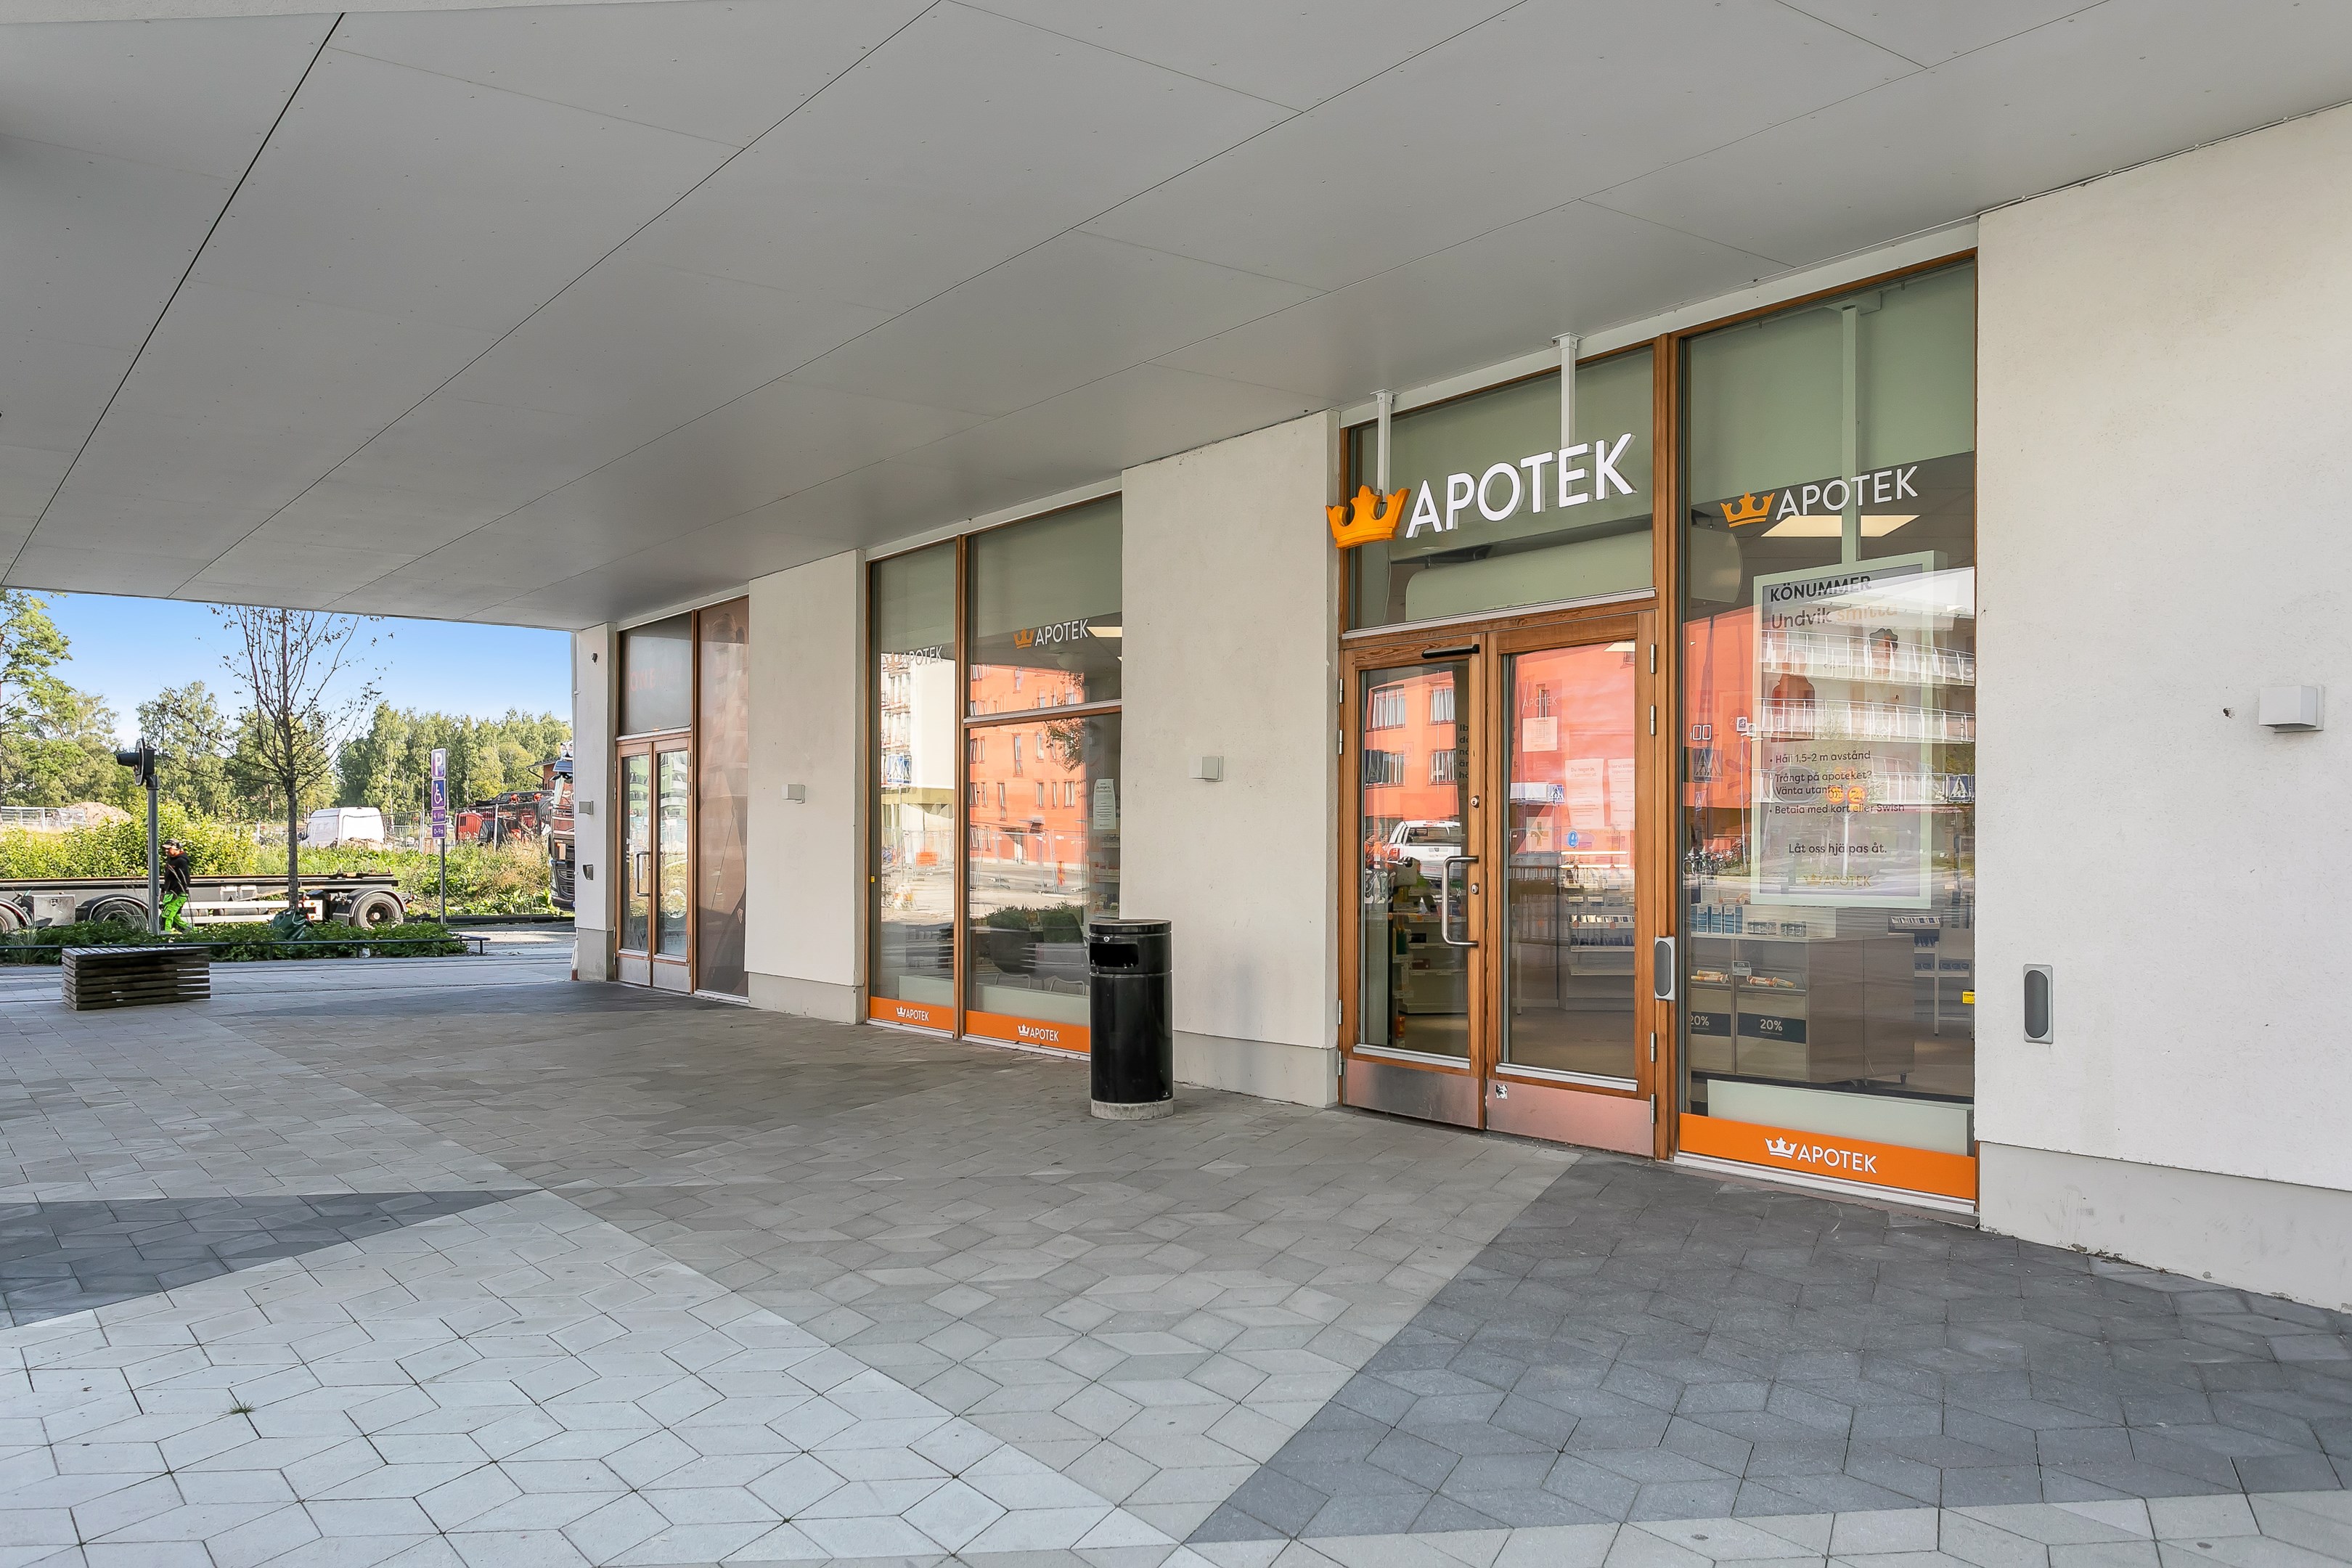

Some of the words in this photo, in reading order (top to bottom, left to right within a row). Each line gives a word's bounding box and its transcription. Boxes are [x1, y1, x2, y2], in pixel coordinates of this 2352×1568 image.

[1405, 433, 1638, 539] APOTEK
[1776, 465, 1919, 520] APOTEK
[1770, 575, 1872, 602] KÖNUMMER
[1771, 608, 1832, 629] Undvik
[1034, 618, 1089, 646] APOTEK
[902, 645, 943, 668] APOTEK
[1523, 696, 1558, 708] APOTEK
[435, 752, 443, 777] P
[1795, 753, 1817, 763] 1,5-2
[1831, 751, 1871, 761] avstånd
[1775, 772, 1805, 784] Trångt
[1807, 771, 1819, 785] på
[1822, 770, 1872, 784] apoteket?
[1776, 785, 1804, 795] Vänta
[1775, 805, 1805, 814] Betala
[1807, 804, 1829, 814] med
[1830, 804, 1850, 813] kort
[1877, 804, 1905, 812] Swish
[1789, 842, 1806, 853] Låt
[1828, 844, 1869, 856] hjäpas
[1871, 842, 1887, 853] åt.
[1823, 875, 1871, 886] APOTEK
[906, 1008, 930, 1022] APOTEK
[1760, 1018, 1783, 1032] 20%
[1029, 1026, 1059, 1042] APOTEK
[1797, 1143, 1877, 1175] APOTEK
